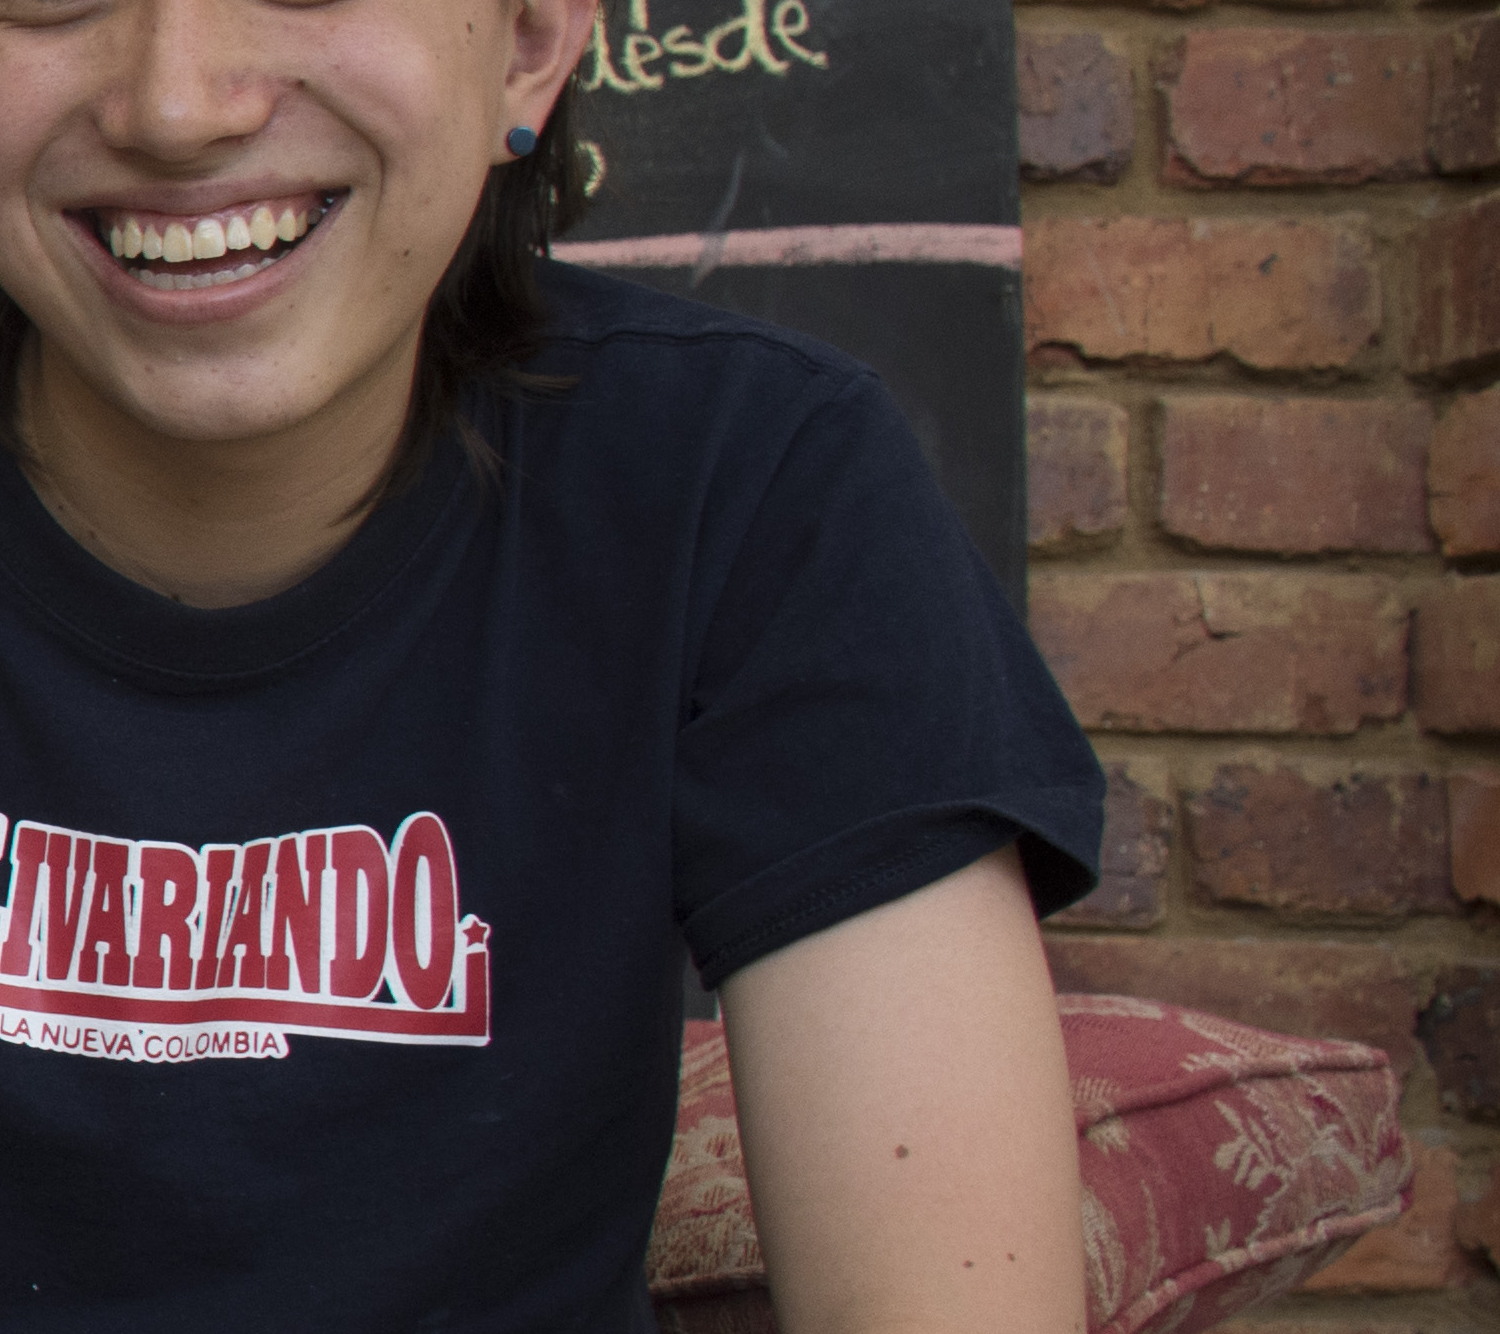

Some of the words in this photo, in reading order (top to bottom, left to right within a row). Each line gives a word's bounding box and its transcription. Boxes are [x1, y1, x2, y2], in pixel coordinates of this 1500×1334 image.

[0, 1013, 33, 1042] LA
[41, 1023, 134, 1057] NUEVA
[144, 1029, 281, 1060] COLOMBIA
